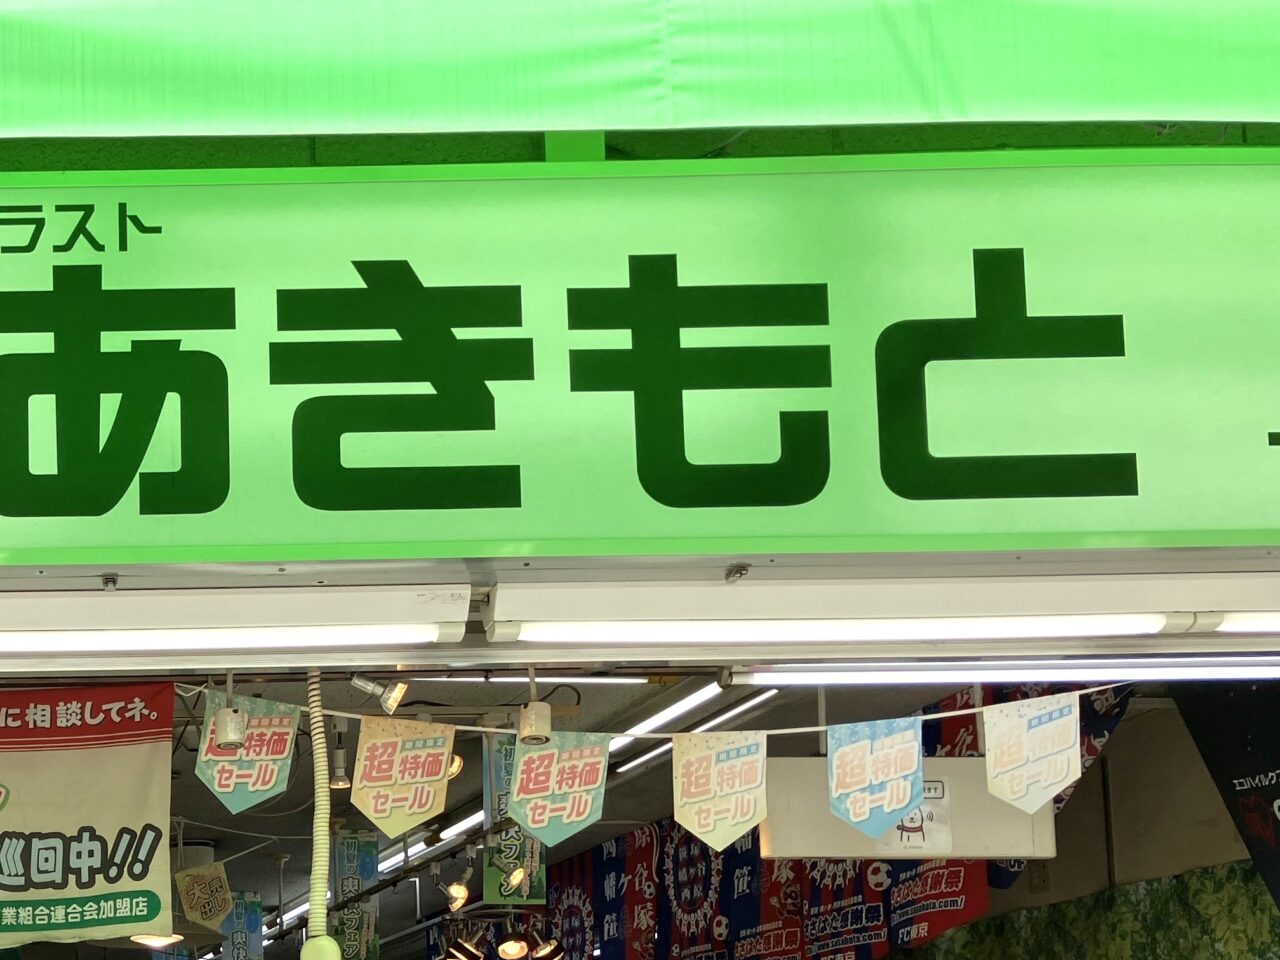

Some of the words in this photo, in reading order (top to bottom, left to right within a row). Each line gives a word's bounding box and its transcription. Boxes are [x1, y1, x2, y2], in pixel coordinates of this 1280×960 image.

[216, 764, 275, 788] セール
[360, 742, 445, 784] 超特価
[517, 752, 602, 797] 超特価
[680, 754, 759, 800] 超特価
[372, 786, 430, 814] セール
[530, 794, 588, 825] セール
[695, 794, 750, 828] セール
[849, 781, 907, 819] セール
[898, 922, 929, 945] FC東京
